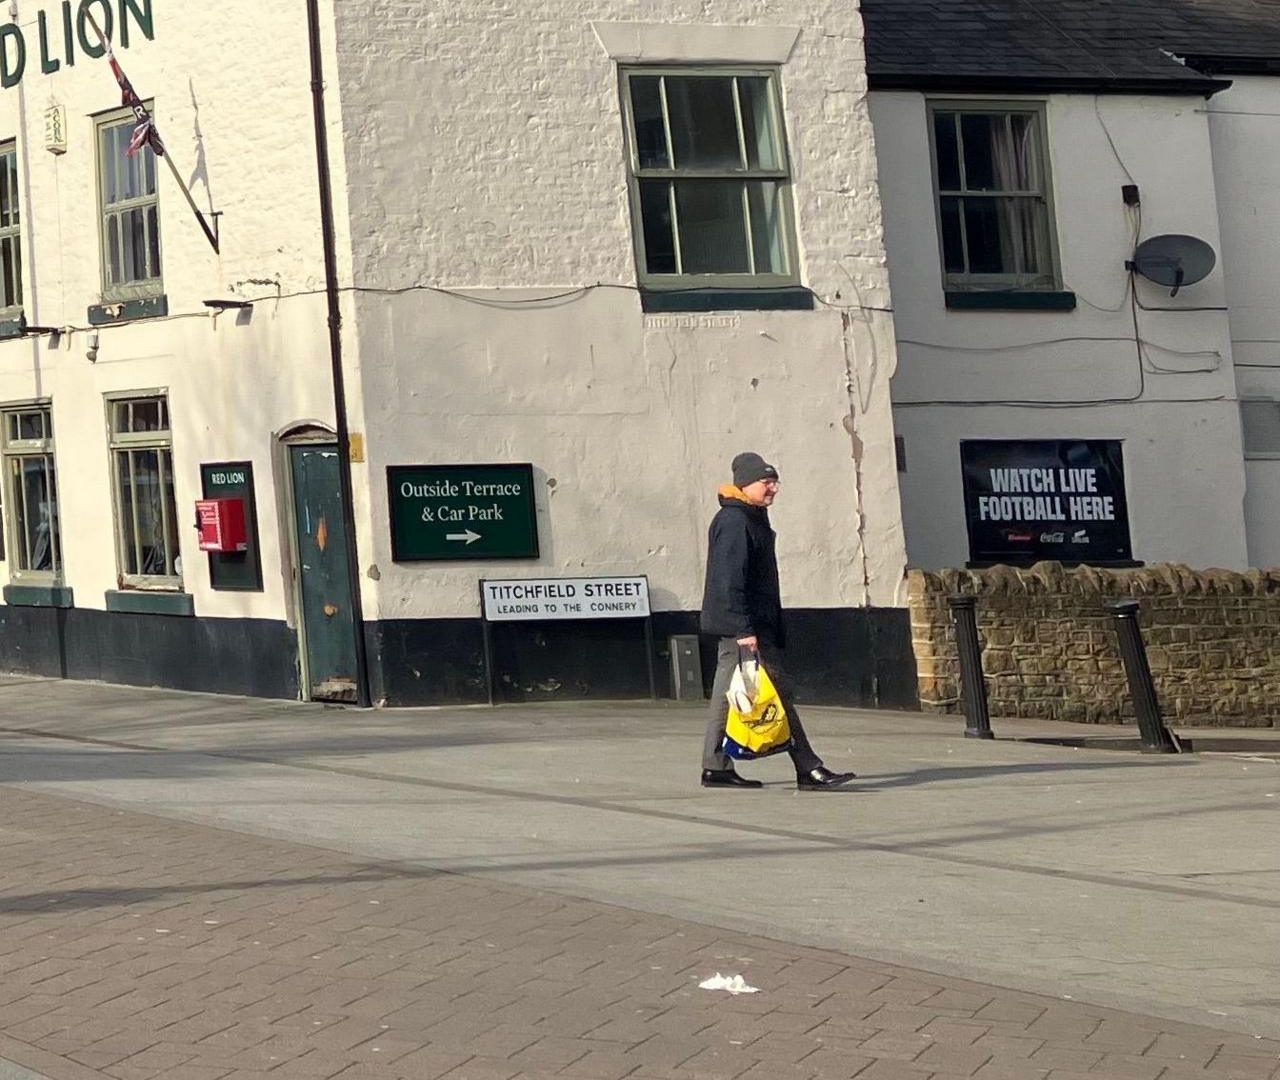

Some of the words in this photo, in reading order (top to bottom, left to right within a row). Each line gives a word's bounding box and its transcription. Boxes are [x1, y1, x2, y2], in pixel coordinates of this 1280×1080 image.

[211, 472, 226, 485] RED
[226, 472, 245, 484] LION
[989, 468, 1056, 493] WATCH
[1059, 468, 1098, 493] LIVE
[400, 480, 459, 498] Outside
[462, 481, 521, 496] Terrace
[421, 506, 434, 522] &
[437, 505, 466, 521] Car
[468, 503, 504, 521] Park
[978, 496, 1067, 521] FOOTBALL
[1069, 496, 1115, 521] HERE
[489, 584, 576, 600] TITCHFIELD
[584, 582, 642, 597] STREET
[497, 604, 539, 615] LEADING
[544, 604, 557, 613] TO
[563, 603, 582, 612] THE
[590, 601, 637, 612] CONNERY
